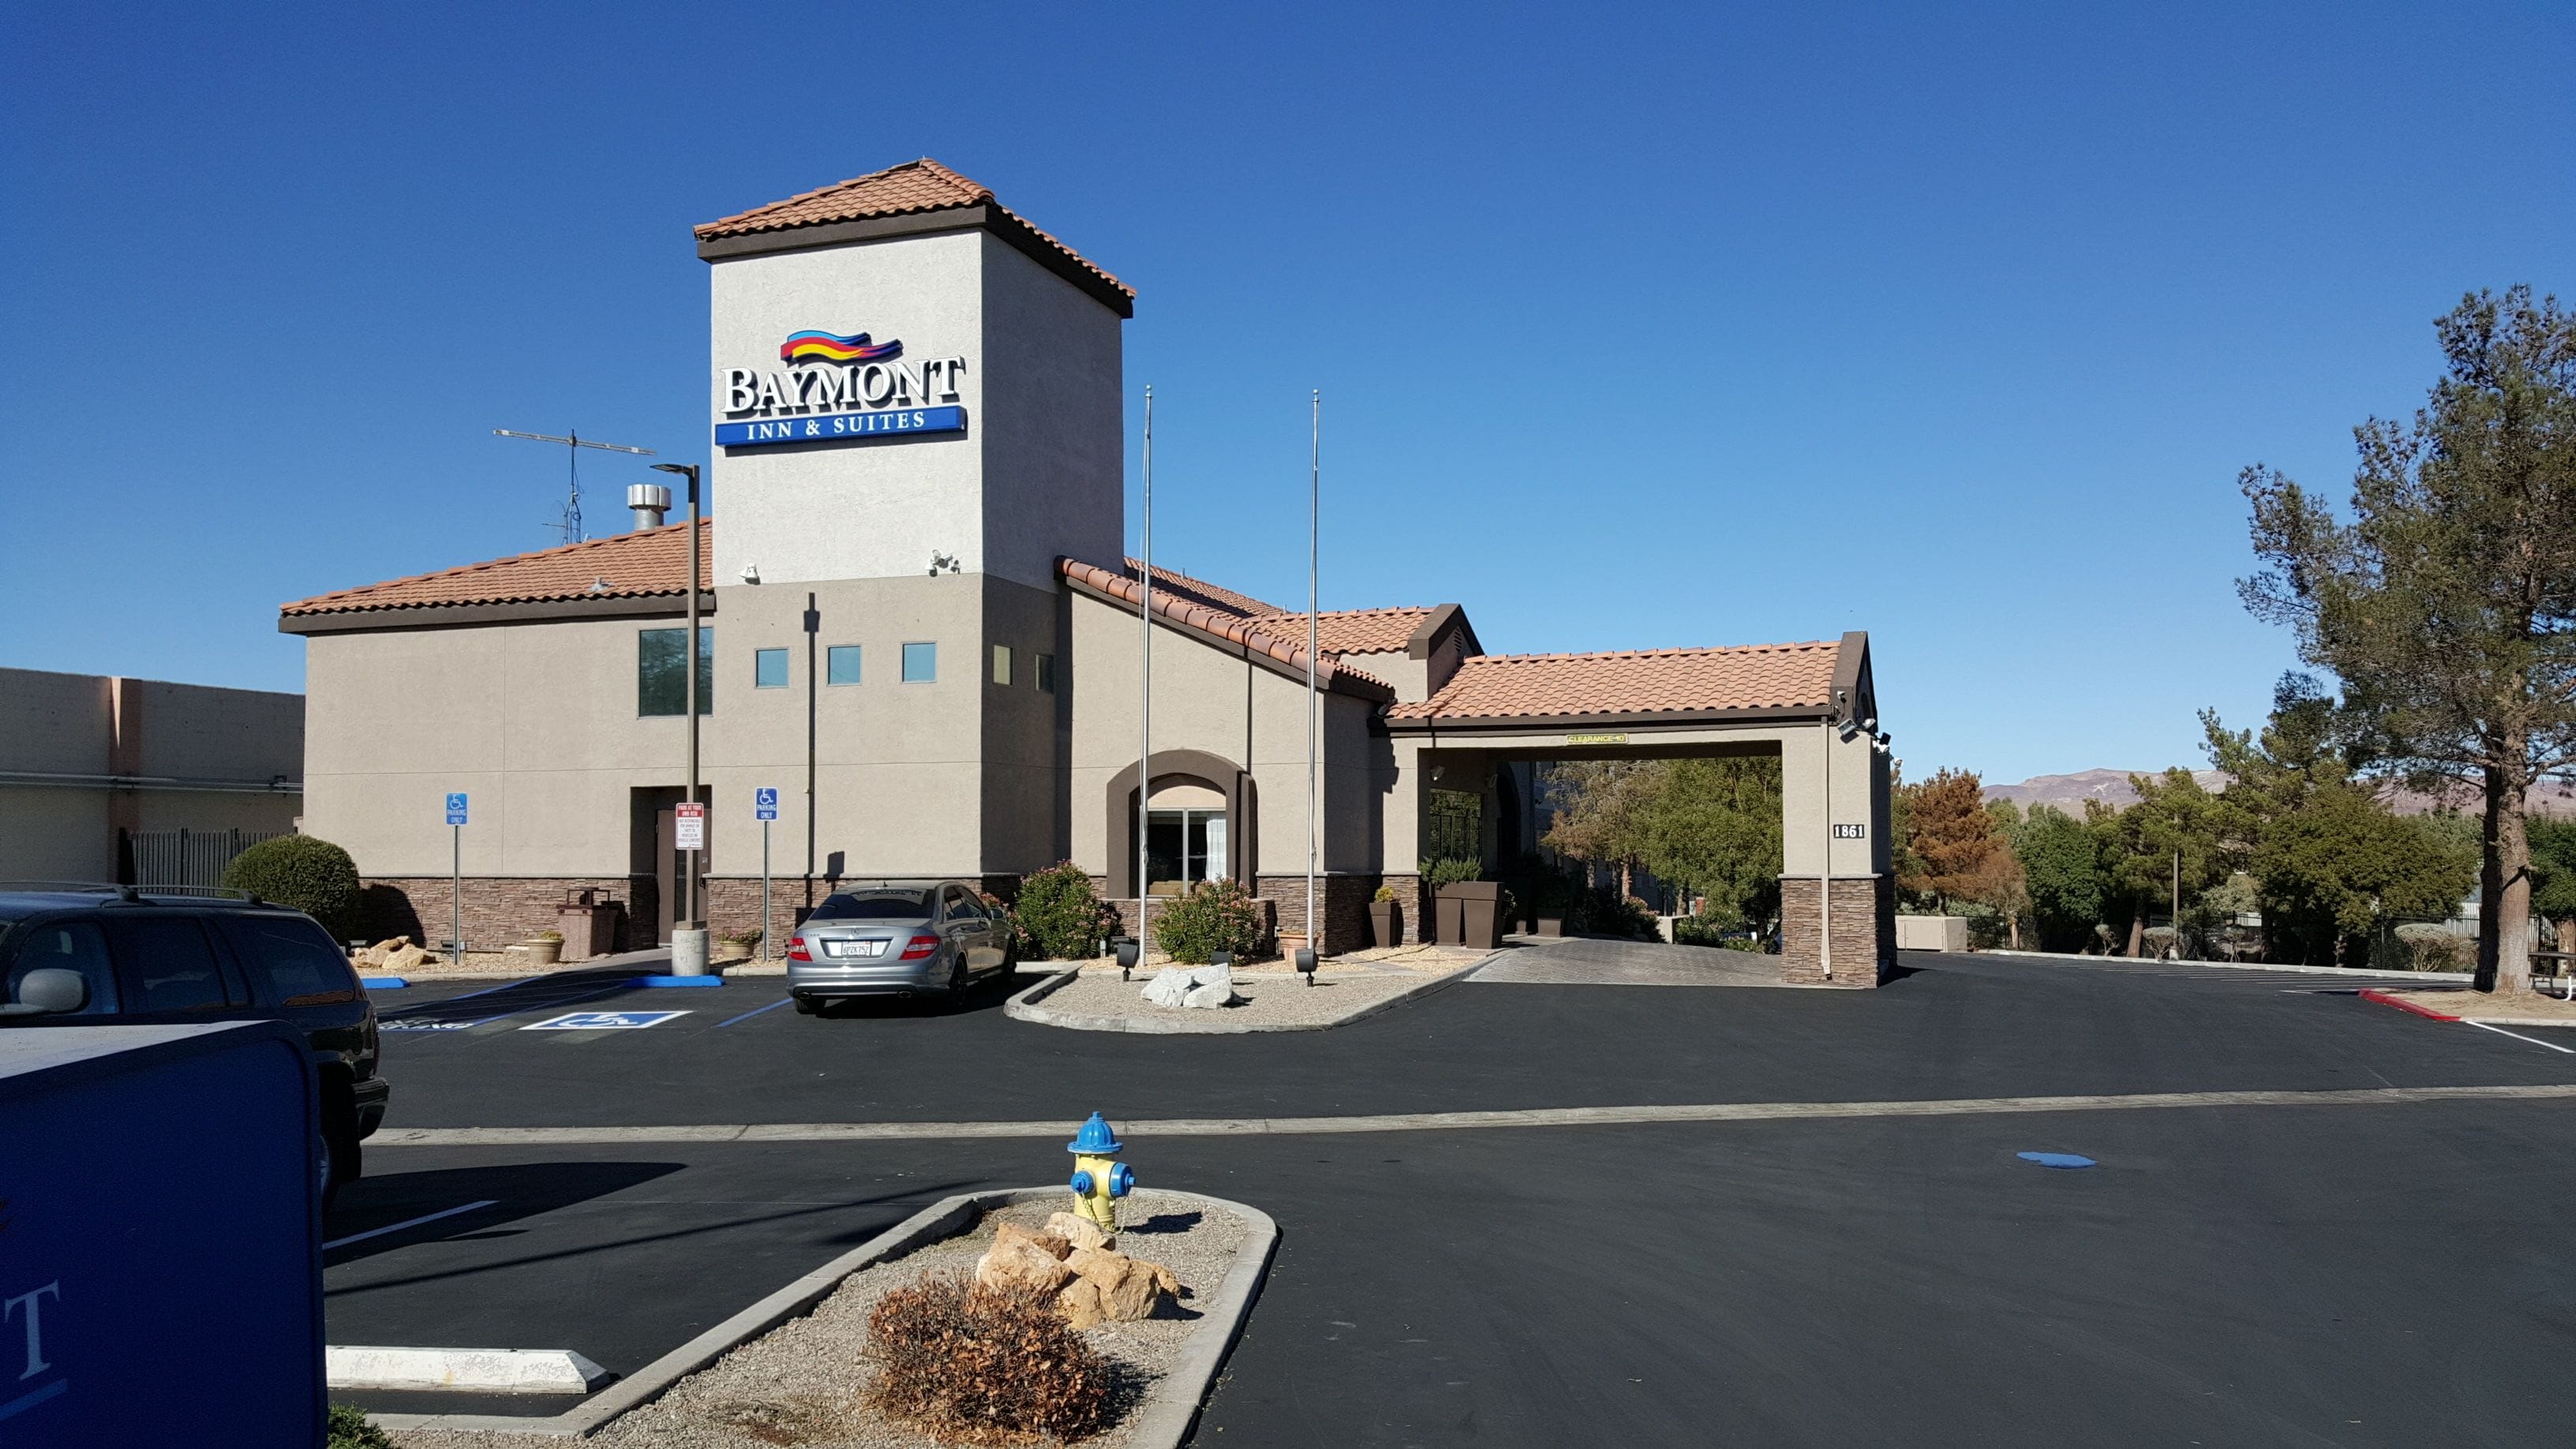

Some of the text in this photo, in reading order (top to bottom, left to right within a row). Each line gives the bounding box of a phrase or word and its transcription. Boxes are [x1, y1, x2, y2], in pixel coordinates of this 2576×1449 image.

[719, 354, 964, 414] BAYMONT
[747, 411, 926, 441] INN & SUITES
[1834, 825, 1863, 837] 1861
